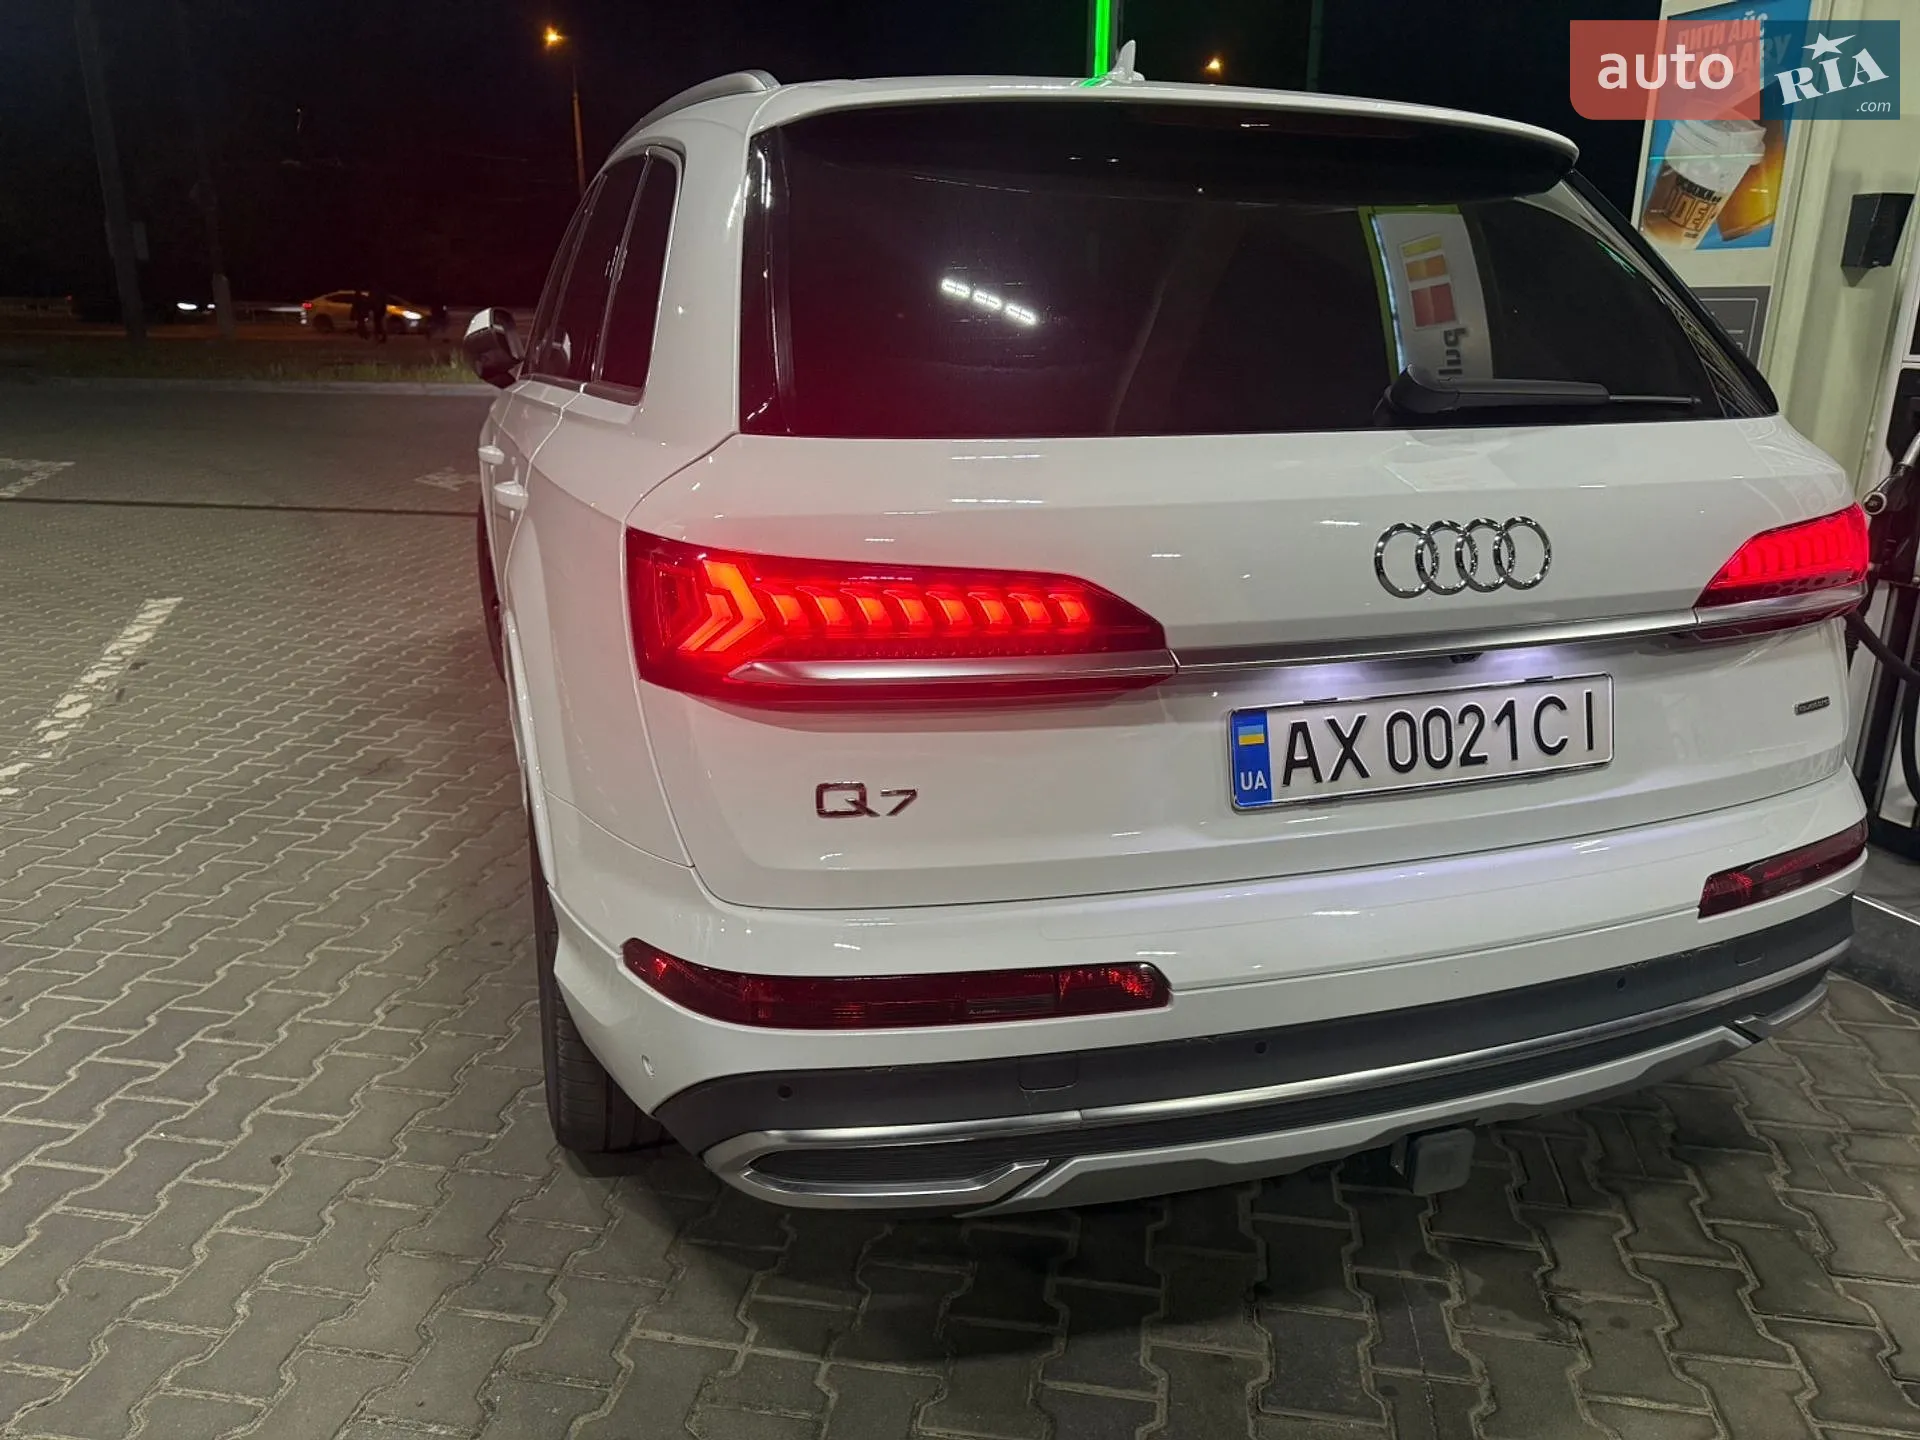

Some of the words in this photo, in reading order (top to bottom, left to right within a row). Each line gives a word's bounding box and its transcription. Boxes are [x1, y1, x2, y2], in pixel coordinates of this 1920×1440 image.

[1282, 713, 1372, 787] AX
[1385, 699, 1519, 774] 0021
[1533, 689, 1594, 756] CI
[1240, 770, 1268, 792] UA
[816, 782, 918, 818] Q7
